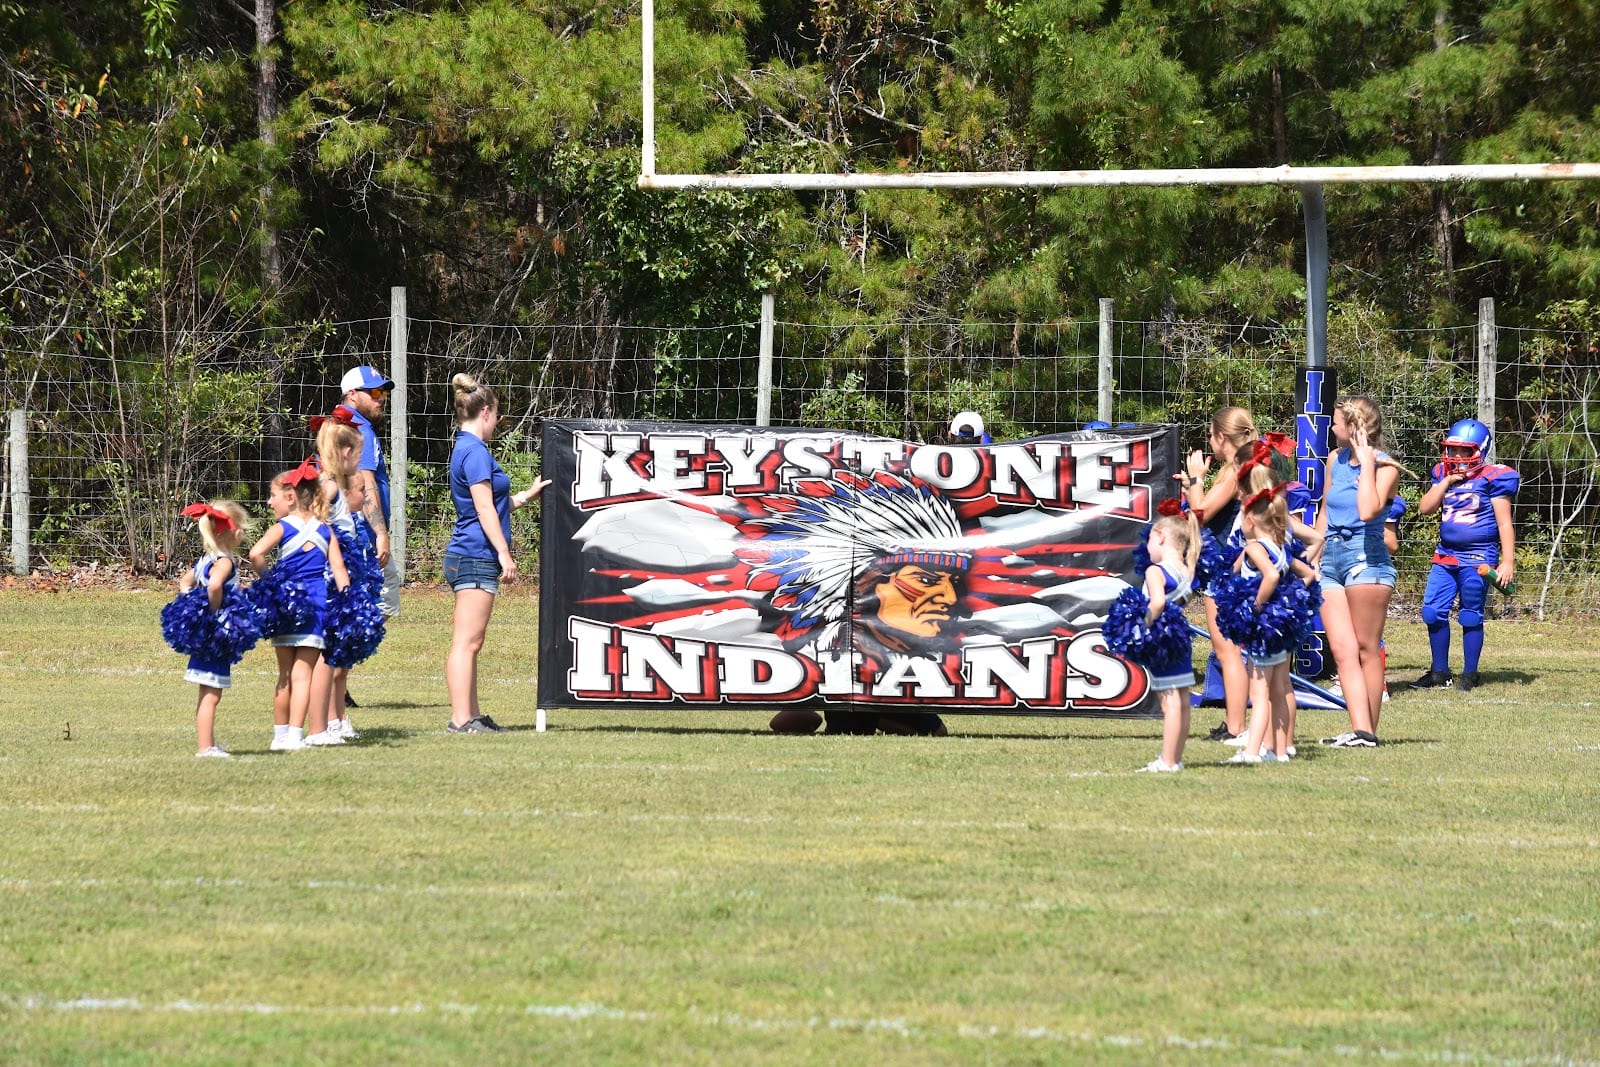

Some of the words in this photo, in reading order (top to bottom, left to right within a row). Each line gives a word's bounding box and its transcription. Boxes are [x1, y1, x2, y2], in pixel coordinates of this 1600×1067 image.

[572, 431, 1150, 521] KEYSTONE
[1296, 370, 1331, 678] INDIS
[568, 616, 1149, 709] INDIANS
